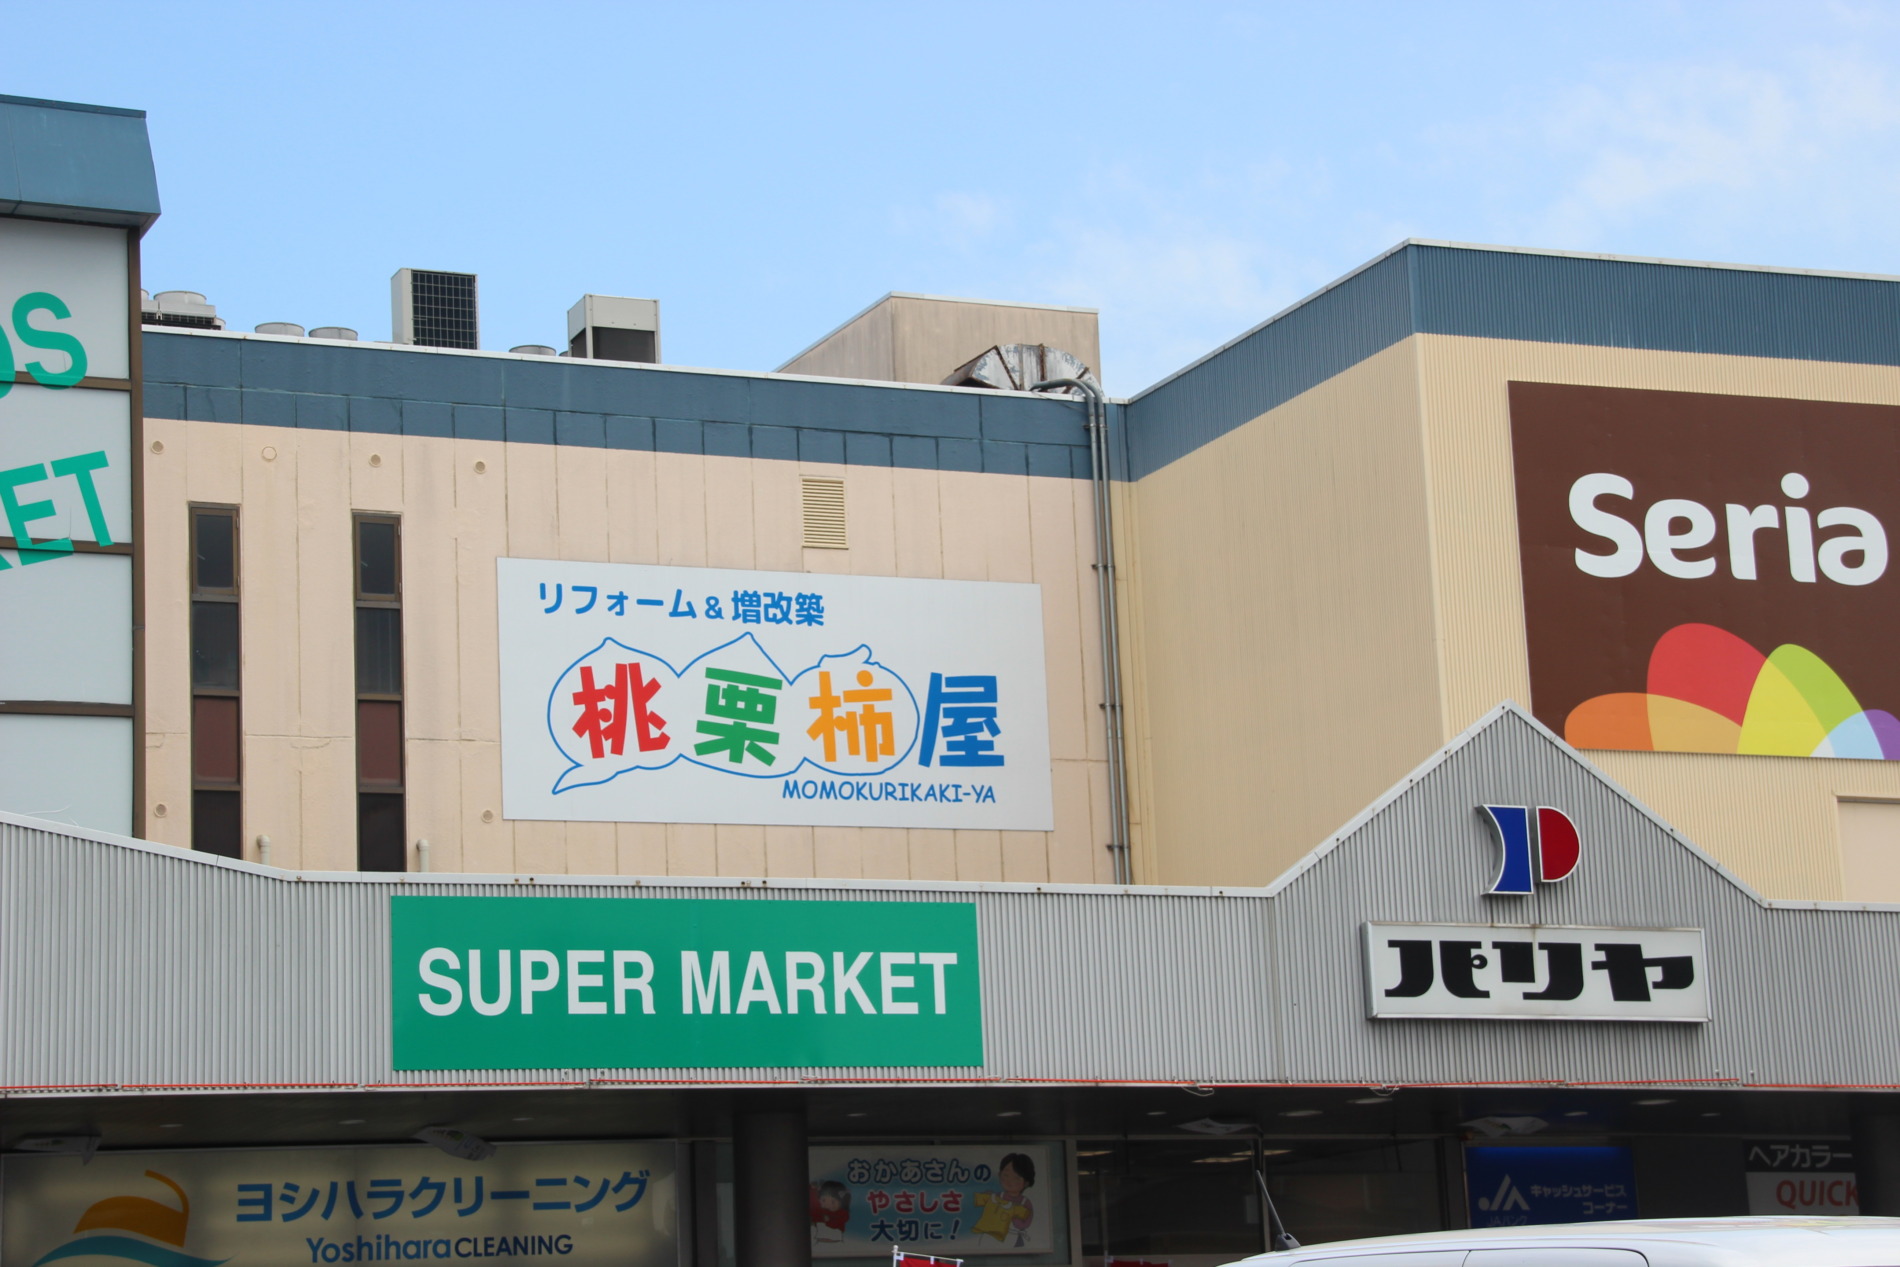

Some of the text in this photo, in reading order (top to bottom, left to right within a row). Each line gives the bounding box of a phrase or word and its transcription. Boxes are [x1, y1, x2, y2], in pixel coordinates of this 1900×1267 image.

[0, 292, 87, 399] S
[0, 451, 114, 571] ET
[1569, 473, 1888, 586] Seria
[572, 662, 1005, 768] 桃栗柿屋
[782, 780, 997, 804] MOMOKURIKAKI-YA
[418, 947, 958, 1016] SUPER MARKET
[1385, 940, 1694, 1002] パリヤ
[1749, 1144, 1853, 1168] ヘアカラー
[848, 1158, 992, 1184] おかあさんの
[236, 1170, 651, 1222] ヨシハラクリーニング
[867, 1190, 964, 1215] やさしさ
[1530, 1184, 1628, 1198] キャッシュサービス
[1776, 1180, 1861, 1209] QUICK
[1583, 1201, 1628, 1215] コーナー
[871, 1219, 960, 1242] 大切に!
